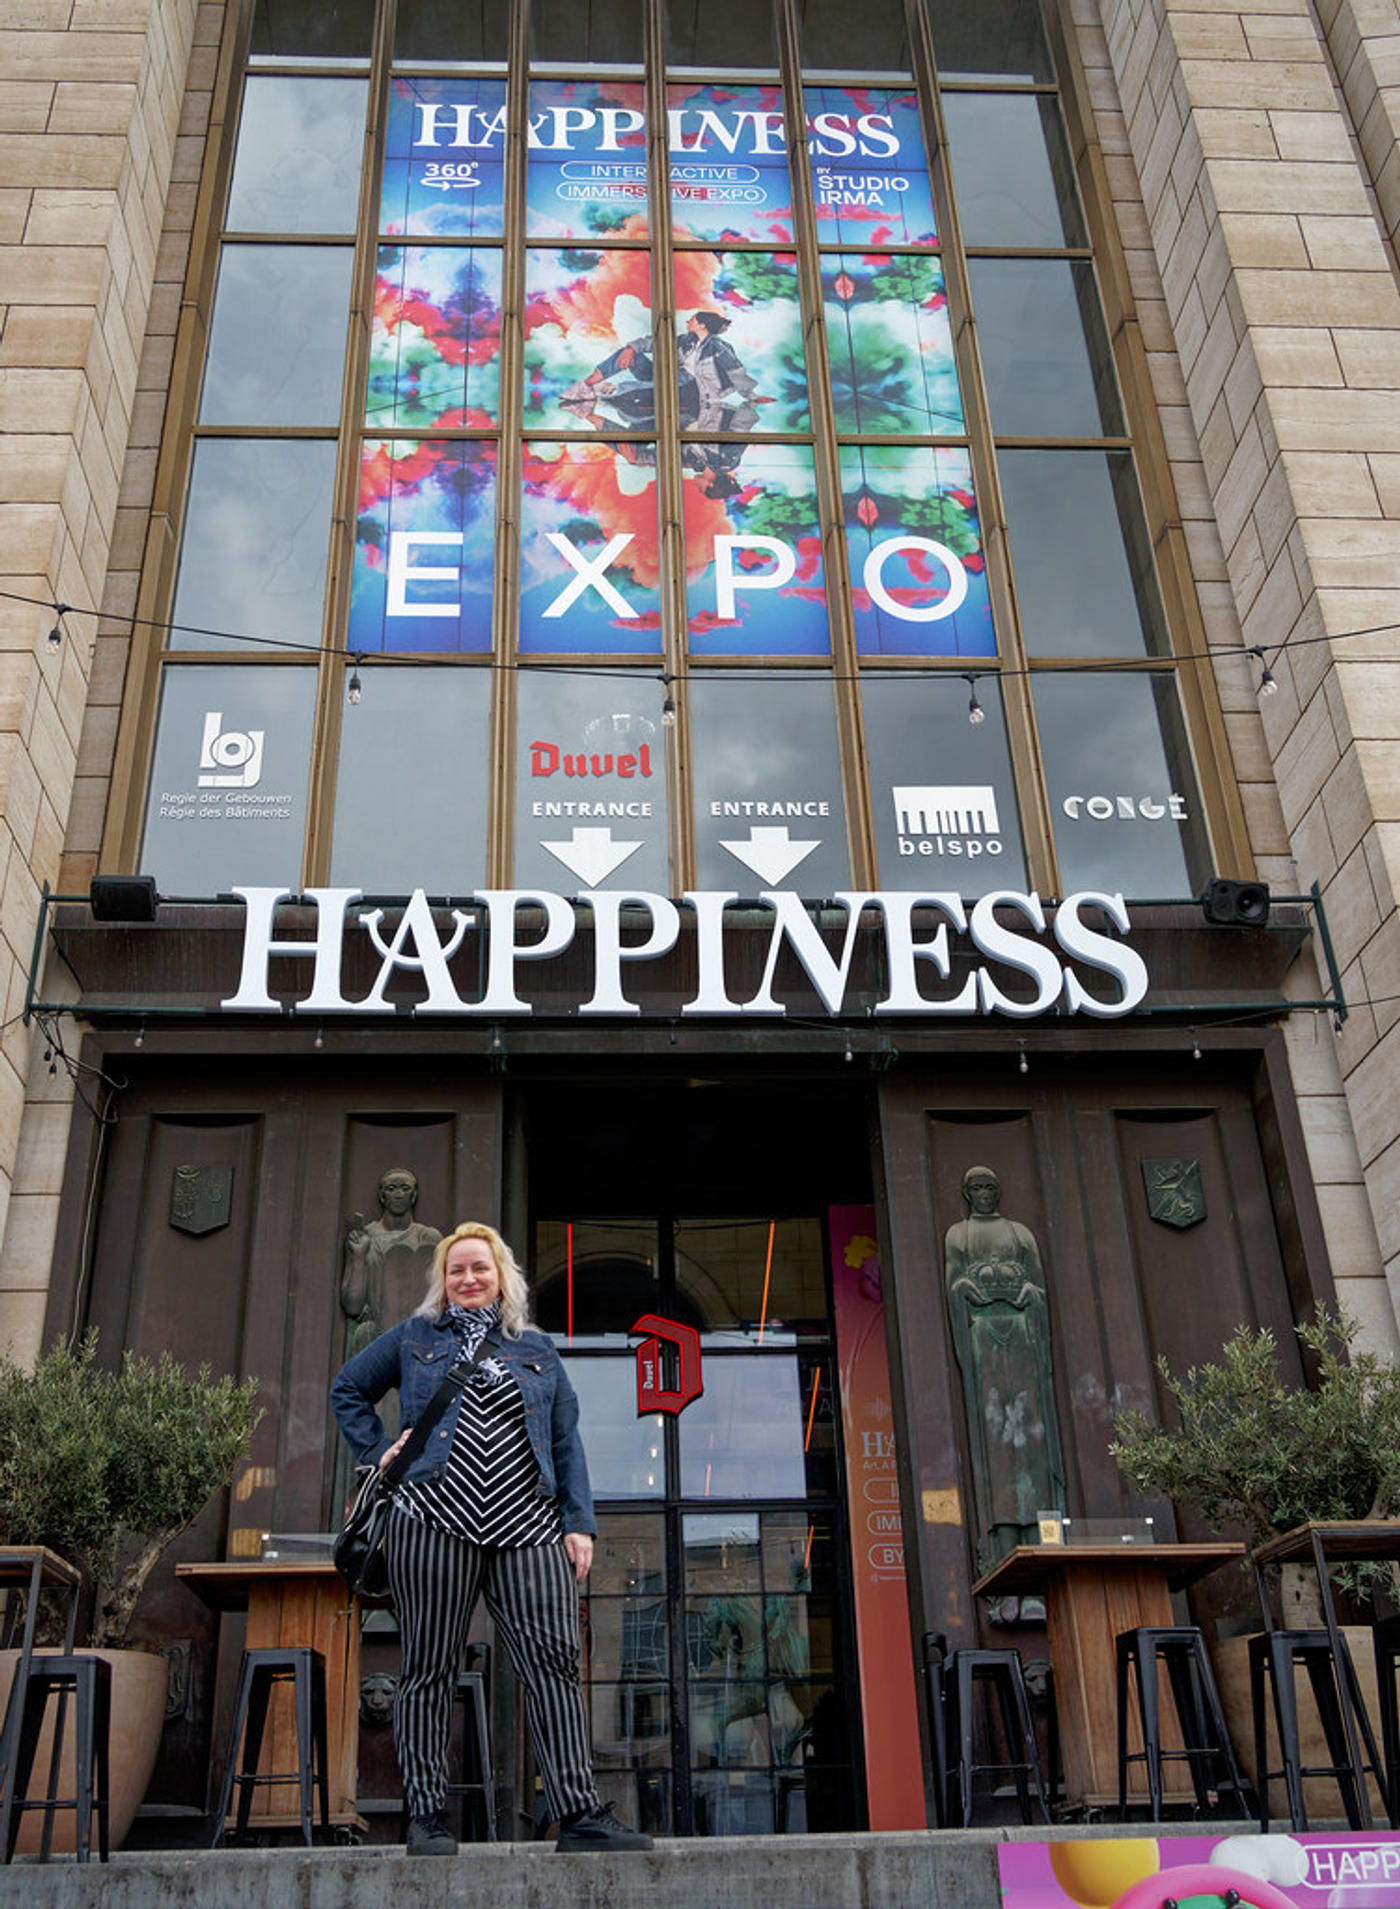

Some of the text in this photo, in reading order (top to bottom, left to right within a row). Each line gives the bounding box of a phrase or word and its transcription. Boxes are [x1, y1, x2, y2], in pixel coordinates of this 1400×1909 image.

[412, 103, 902, 158] HAPPINESS
[591, 165, 738, 180] INTERACTIVE
[818, 175, 910, 191] STUDIO
[567, 185, 760, 200] IMMERSIVE EXPO
[820, 190, 884, 206] IRMA
[384, 531, 969, 623] EXPO
[529, 740, 653, 778] Duvel
[161, 792, 197, 806] Regie
[200, 792, 222, 804] der
[160, 806, 195, 820] Régie
[199, 806, 222, 818] des
[532, 801, 653, 817] ENTRANCE
[711, 801, 830, 817] ENTRANCE
[898, 836, 1003, 859] belspo
[219, 886, 1150, 1018] HAPPINESS
